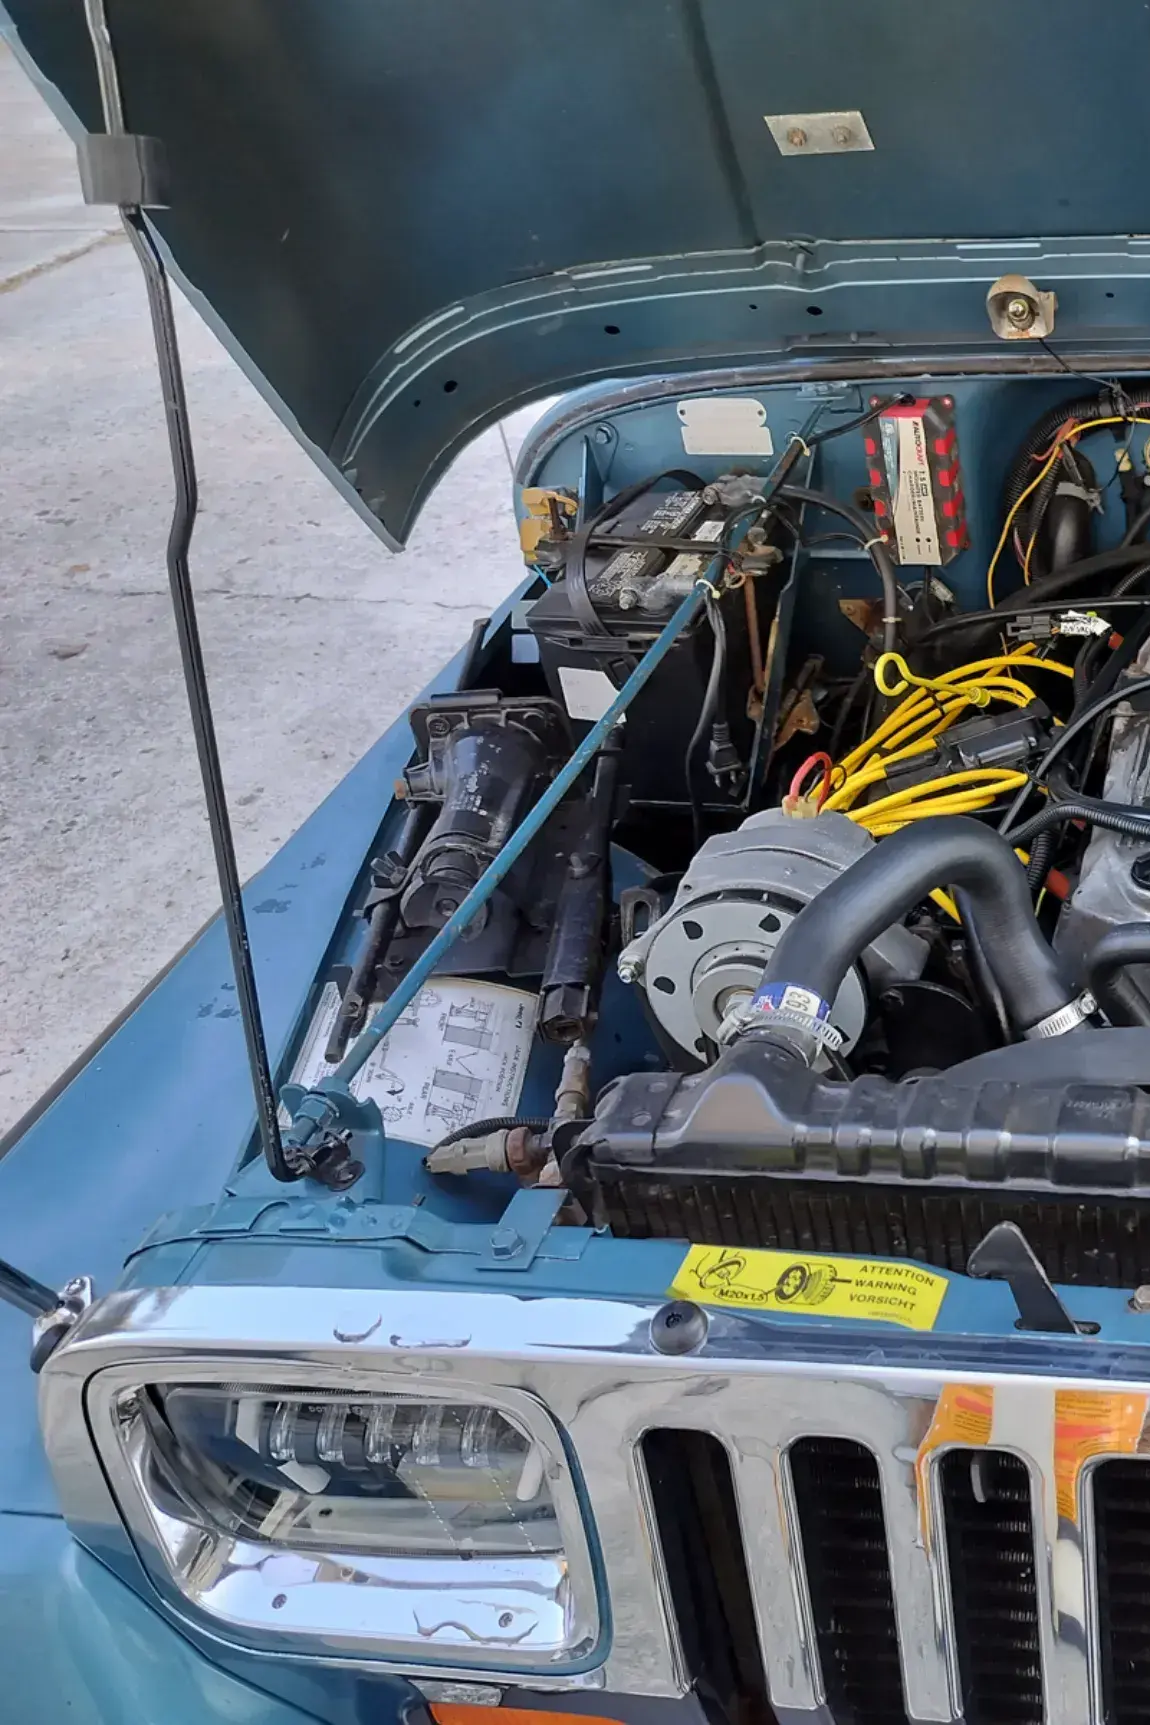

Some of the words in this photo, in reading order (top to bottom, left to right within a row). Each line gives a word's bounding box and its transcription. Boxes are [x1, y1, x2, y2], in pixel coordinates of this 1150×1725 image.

[859, 1265, 935, 1287] ATTENTION
[855, 1279, 917, 1296] WARNING
[849, 1292, 916, 1311] VORSICHT
